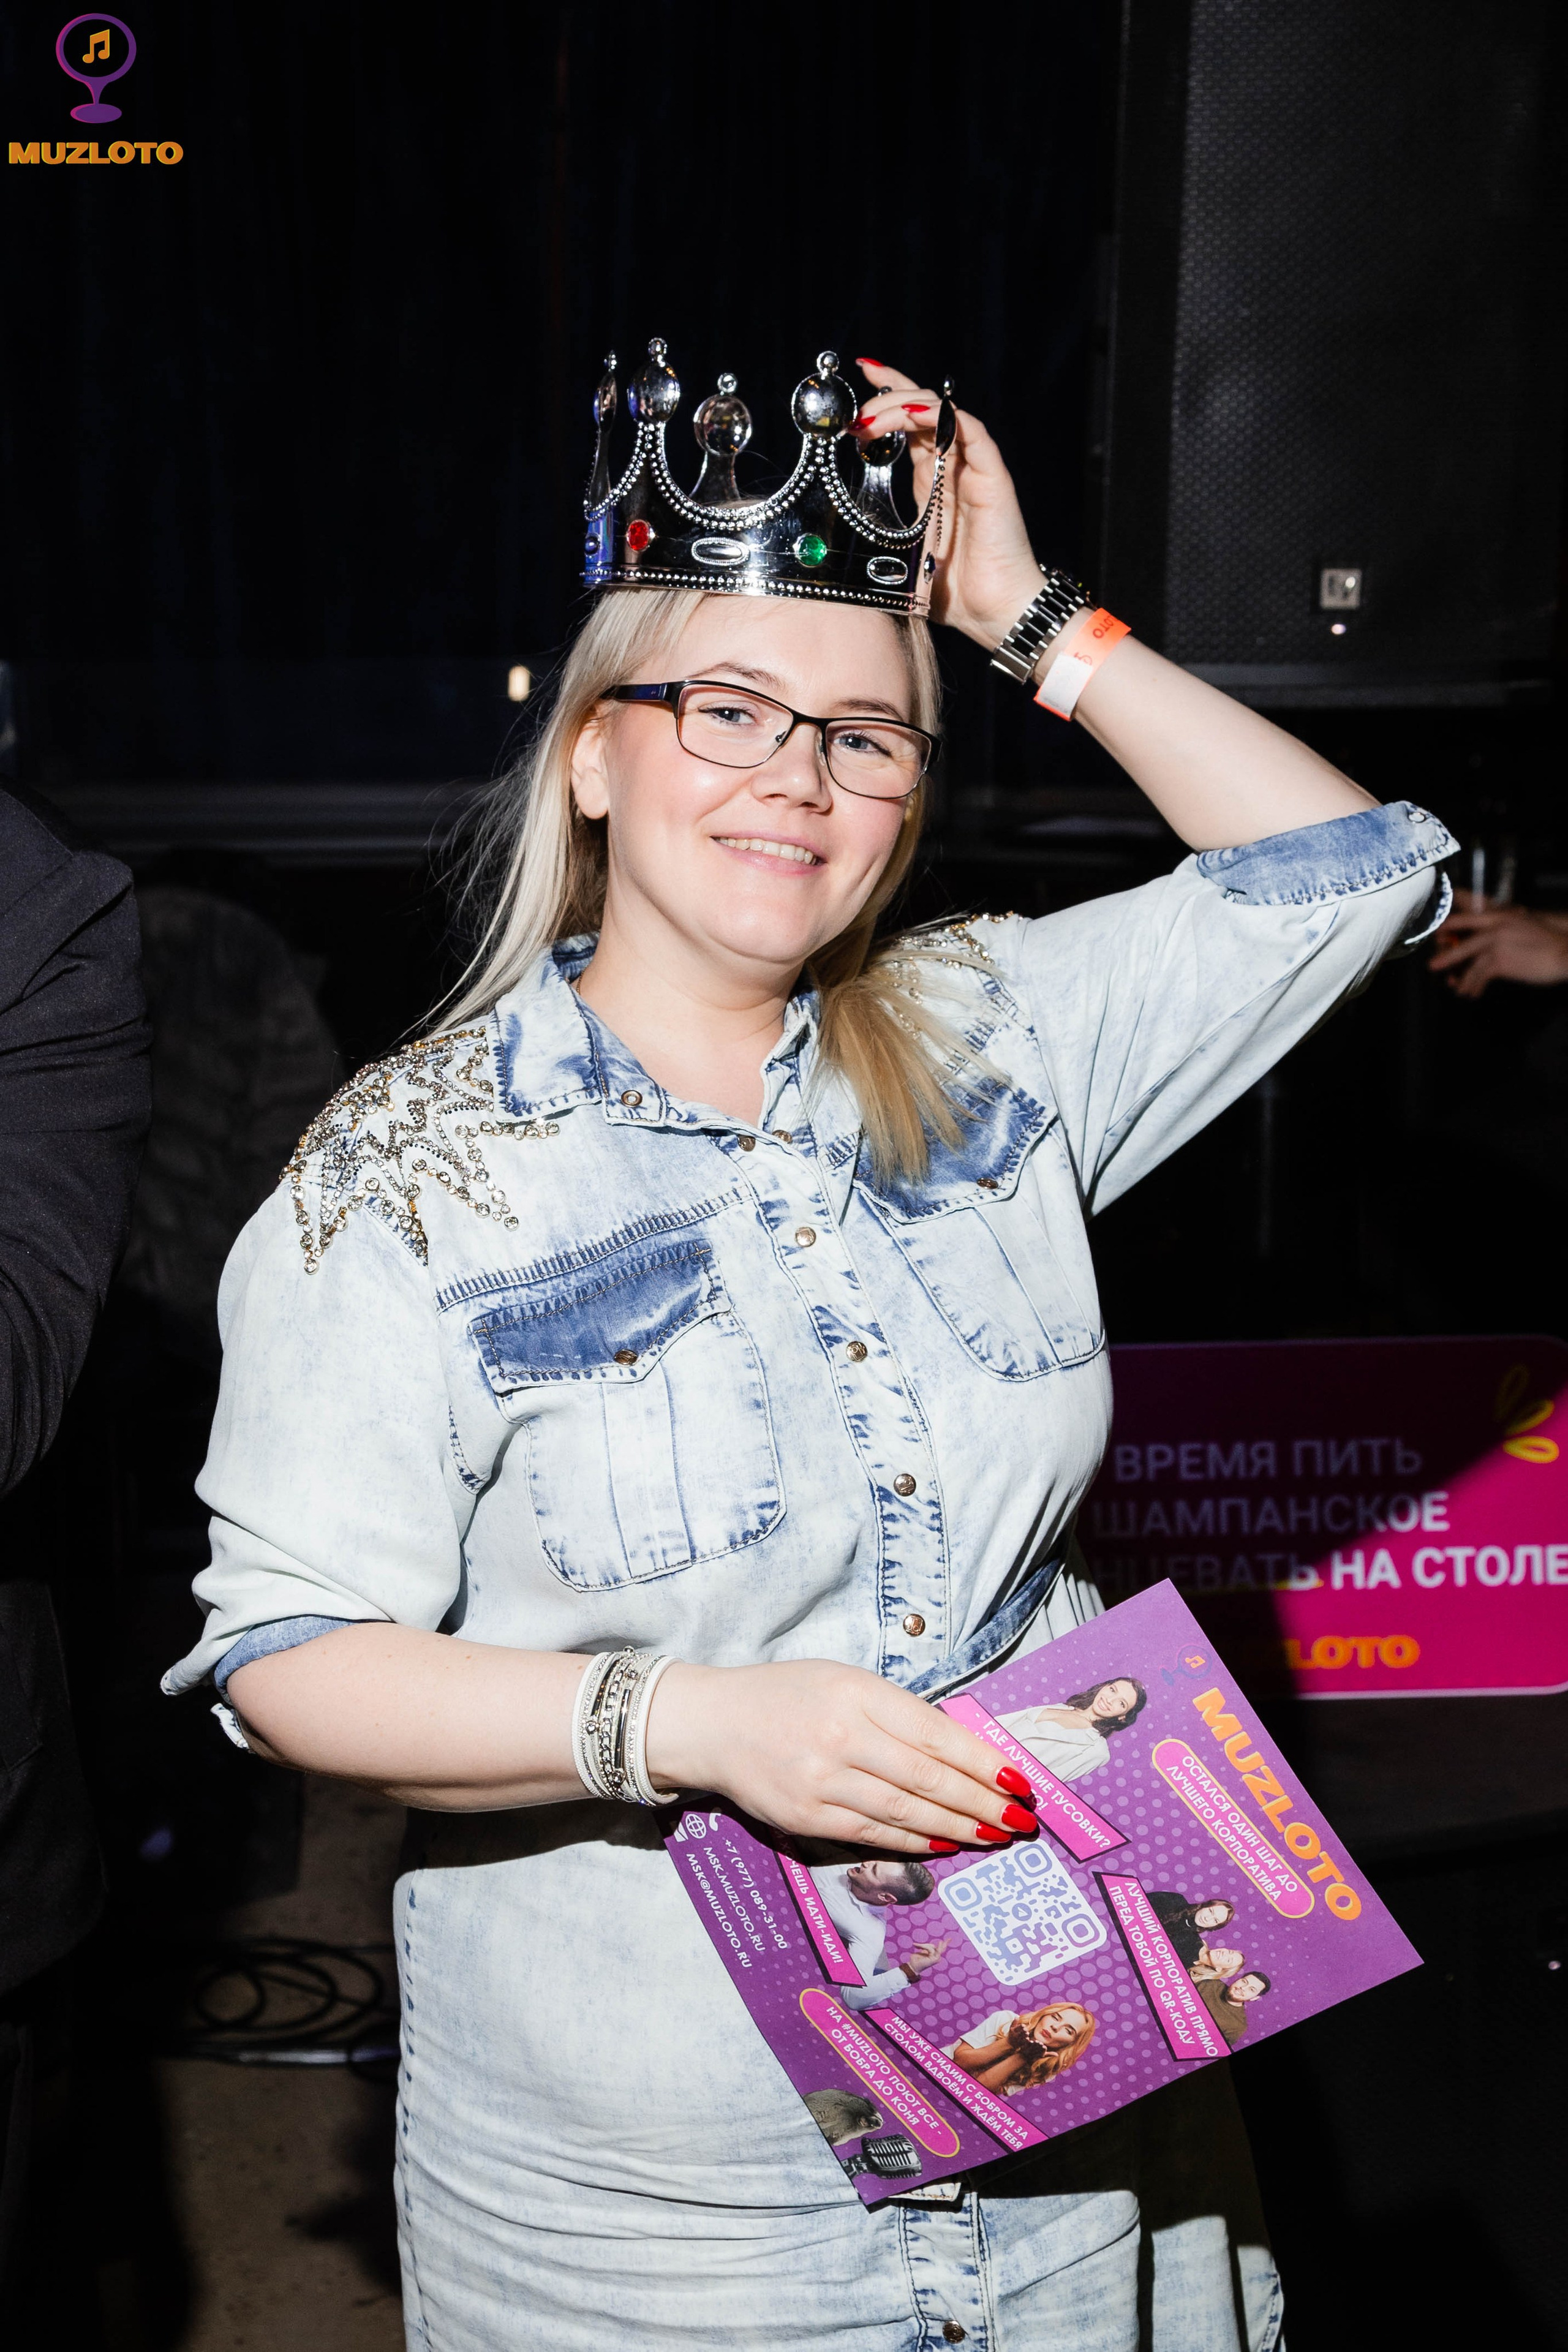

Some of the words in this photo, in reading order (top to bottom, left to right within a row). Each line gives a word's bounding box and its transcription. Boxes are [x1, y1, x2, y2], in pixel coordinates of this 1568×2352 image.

[1091, 1491, 1450, 1539] ШАМПАНСКОЕ
[1114, 1442, 1277, 1483] ВРЕМЯ
[1292, 1437, 1423, 1477] ПИТЬ
[1093, 1551, 1321, 1593] НЦЕВАТЬ
[1330, 1547, 1403, 1591] НА
[1411, 1544, 1568, 1588] СТОЛЕ
[1282, 1634, 1421, 1670] LOTO
[983, 1721, 1009, 1746] ГДЕ
[1003, 1745, 1055, 1793] ЛУЧШИЕ
[1051, 1790, 1111, 1848] ТУСОВКИ?
[1167, 1765, 1215, 1819] ЛУЧШЕГО
[1212, 1819, 1283, 1901] КОРПОРАТИВА
[1182, 1756, 1232, 1813] ОСТАЛСЯ
[1227, 1812, 1261, 1847] ОДИН
[1256, 1840, 1283, 1874] ШАГ
[1276, 1873, 1298, 1893] ДО
[1193, 1687, 1362, 1920] MUZLOTO
[704, 1847, 766, 1952] MSK.MUZLOTO.RU
[725, 1839, 738, 1855] +7
[731, 1856, 755, 1888] (977)
[686, 1853, 752, 1968] MSK@MUZLOTO.RU
[750, 1890, 788, 1950] 089-31-00
[804, 1897, 843, 1964] ИДТИ-ИДИ!
[1109, 1886, 1135, 1926] ПЕРЕД
[1128, 1924, 1157, 1968] ТОБОЙ
[1148, 1969, 1166, 1989] ПО
[1159, 1990, 1195, 2045] QR-КОДУ
[1125, 1882, 1162, 1934] ЛУЧШИЙ
[1152, 1935, 1197, 2014] КОРПОРАТИВ
[1190, 2015, 1218, 2057] ПРЯМО
[827, 2006, 842, 2024] НА
[841, 2023, 891, 2075] #MUZLOTO
[888, 2075, 921, 2108] ПОЮТ
[918, 2108, 940, 2130] ВСЕ
[831, 2029, 848, 2044] ОТ
[843, 2044, 876, 2079] БОБРА
[873, 2079, 893, 2096] ДО
[891, 2096, 920, 2126] КОНЯ
[884, 2023, 925, 2063] СТОЛОМ
[924, 2061, 965, 2099] ВДВОЁМ
[962, 2096, 973, 2105] И
[971, 2104, 1001, 2132] ЖДЁМ
[1000, 2130, 1023, 2150] ТЕБЯ
[891, 2016, 910, 2034] МЫ
[910, 2034, 932, 2052] УЖЕ
[930, 2052, 967, 2086] СИДИМ
[966, 2083, 976, 2092] С
[974, 2090, 1016, 2128] БОБРОМ
[1014, 2127, 1028, 2140] ЗА
